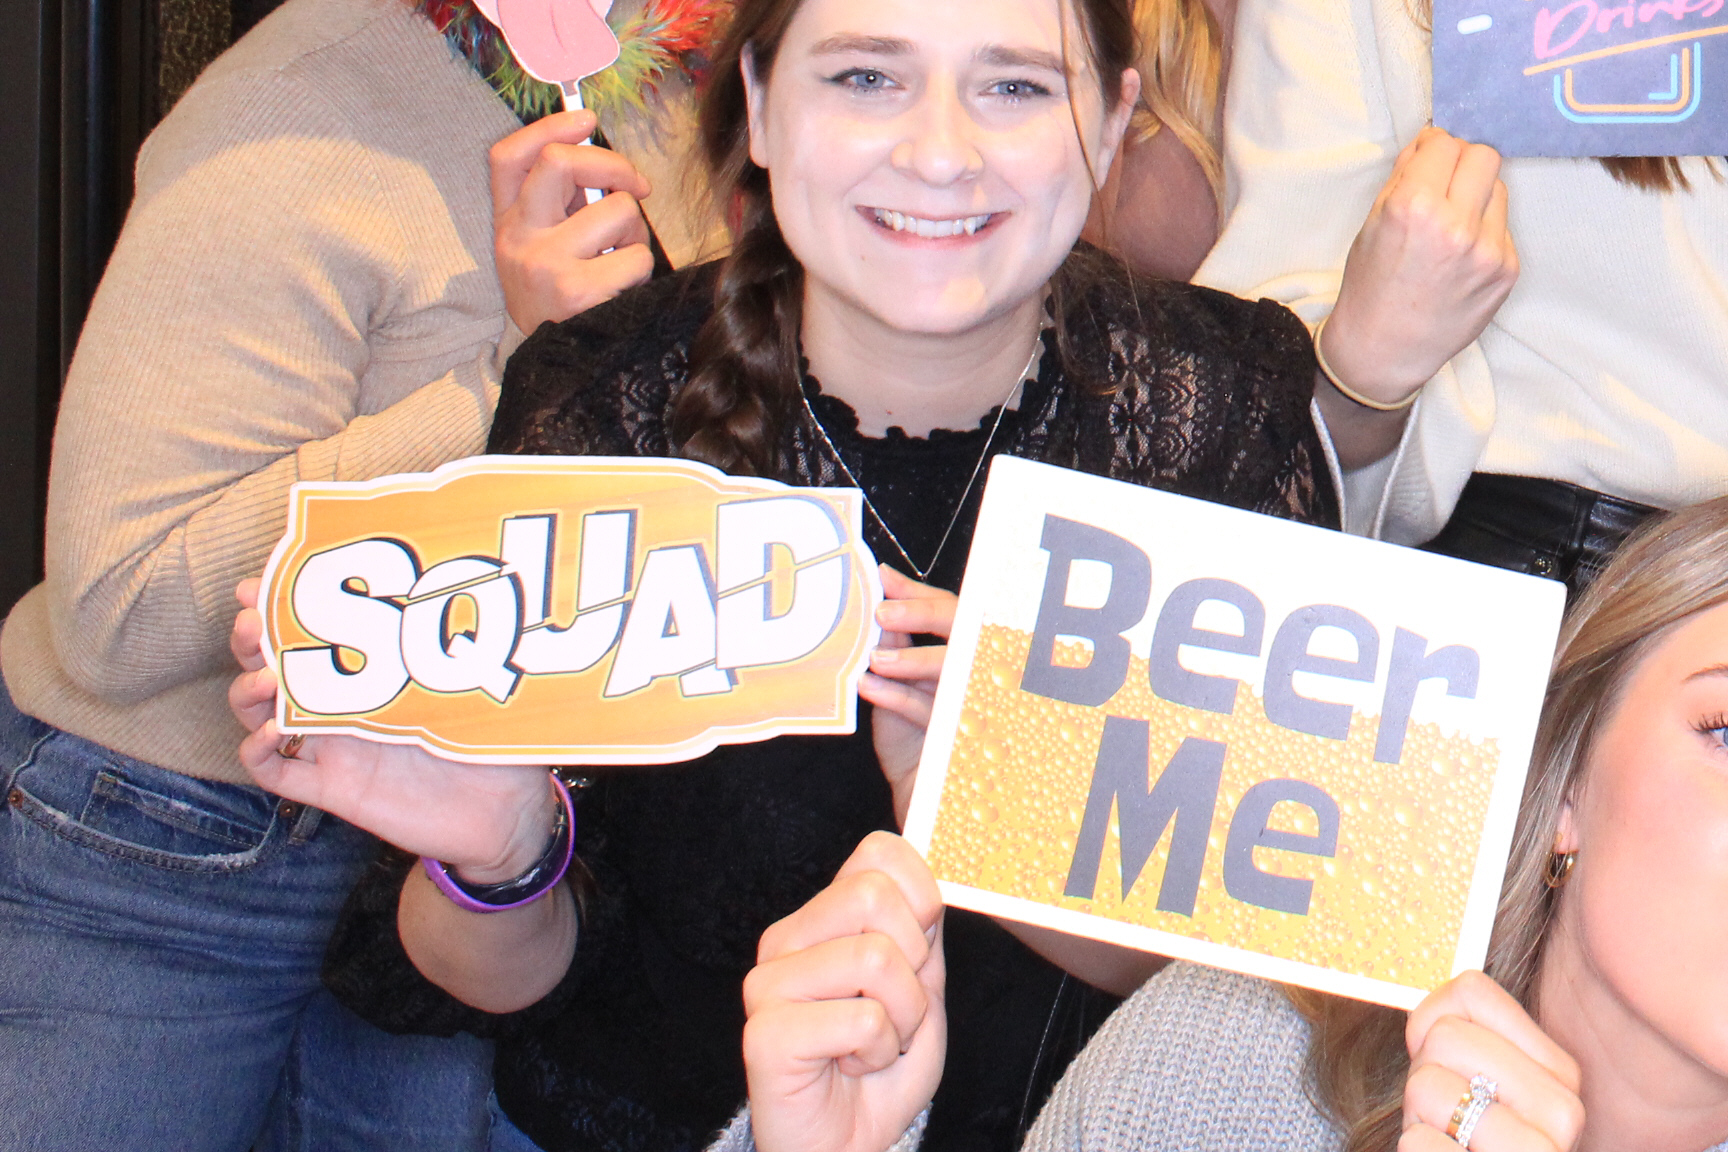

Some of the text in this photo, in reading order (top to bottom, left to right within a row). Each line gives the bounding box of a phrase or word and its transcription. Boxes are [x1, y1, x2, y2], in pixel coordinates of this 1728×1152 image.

[281, 495, 849, 715] SQUAD
[1019, 513, 1480, 765] Beer
[1063, 715, 1340, 918] Me
